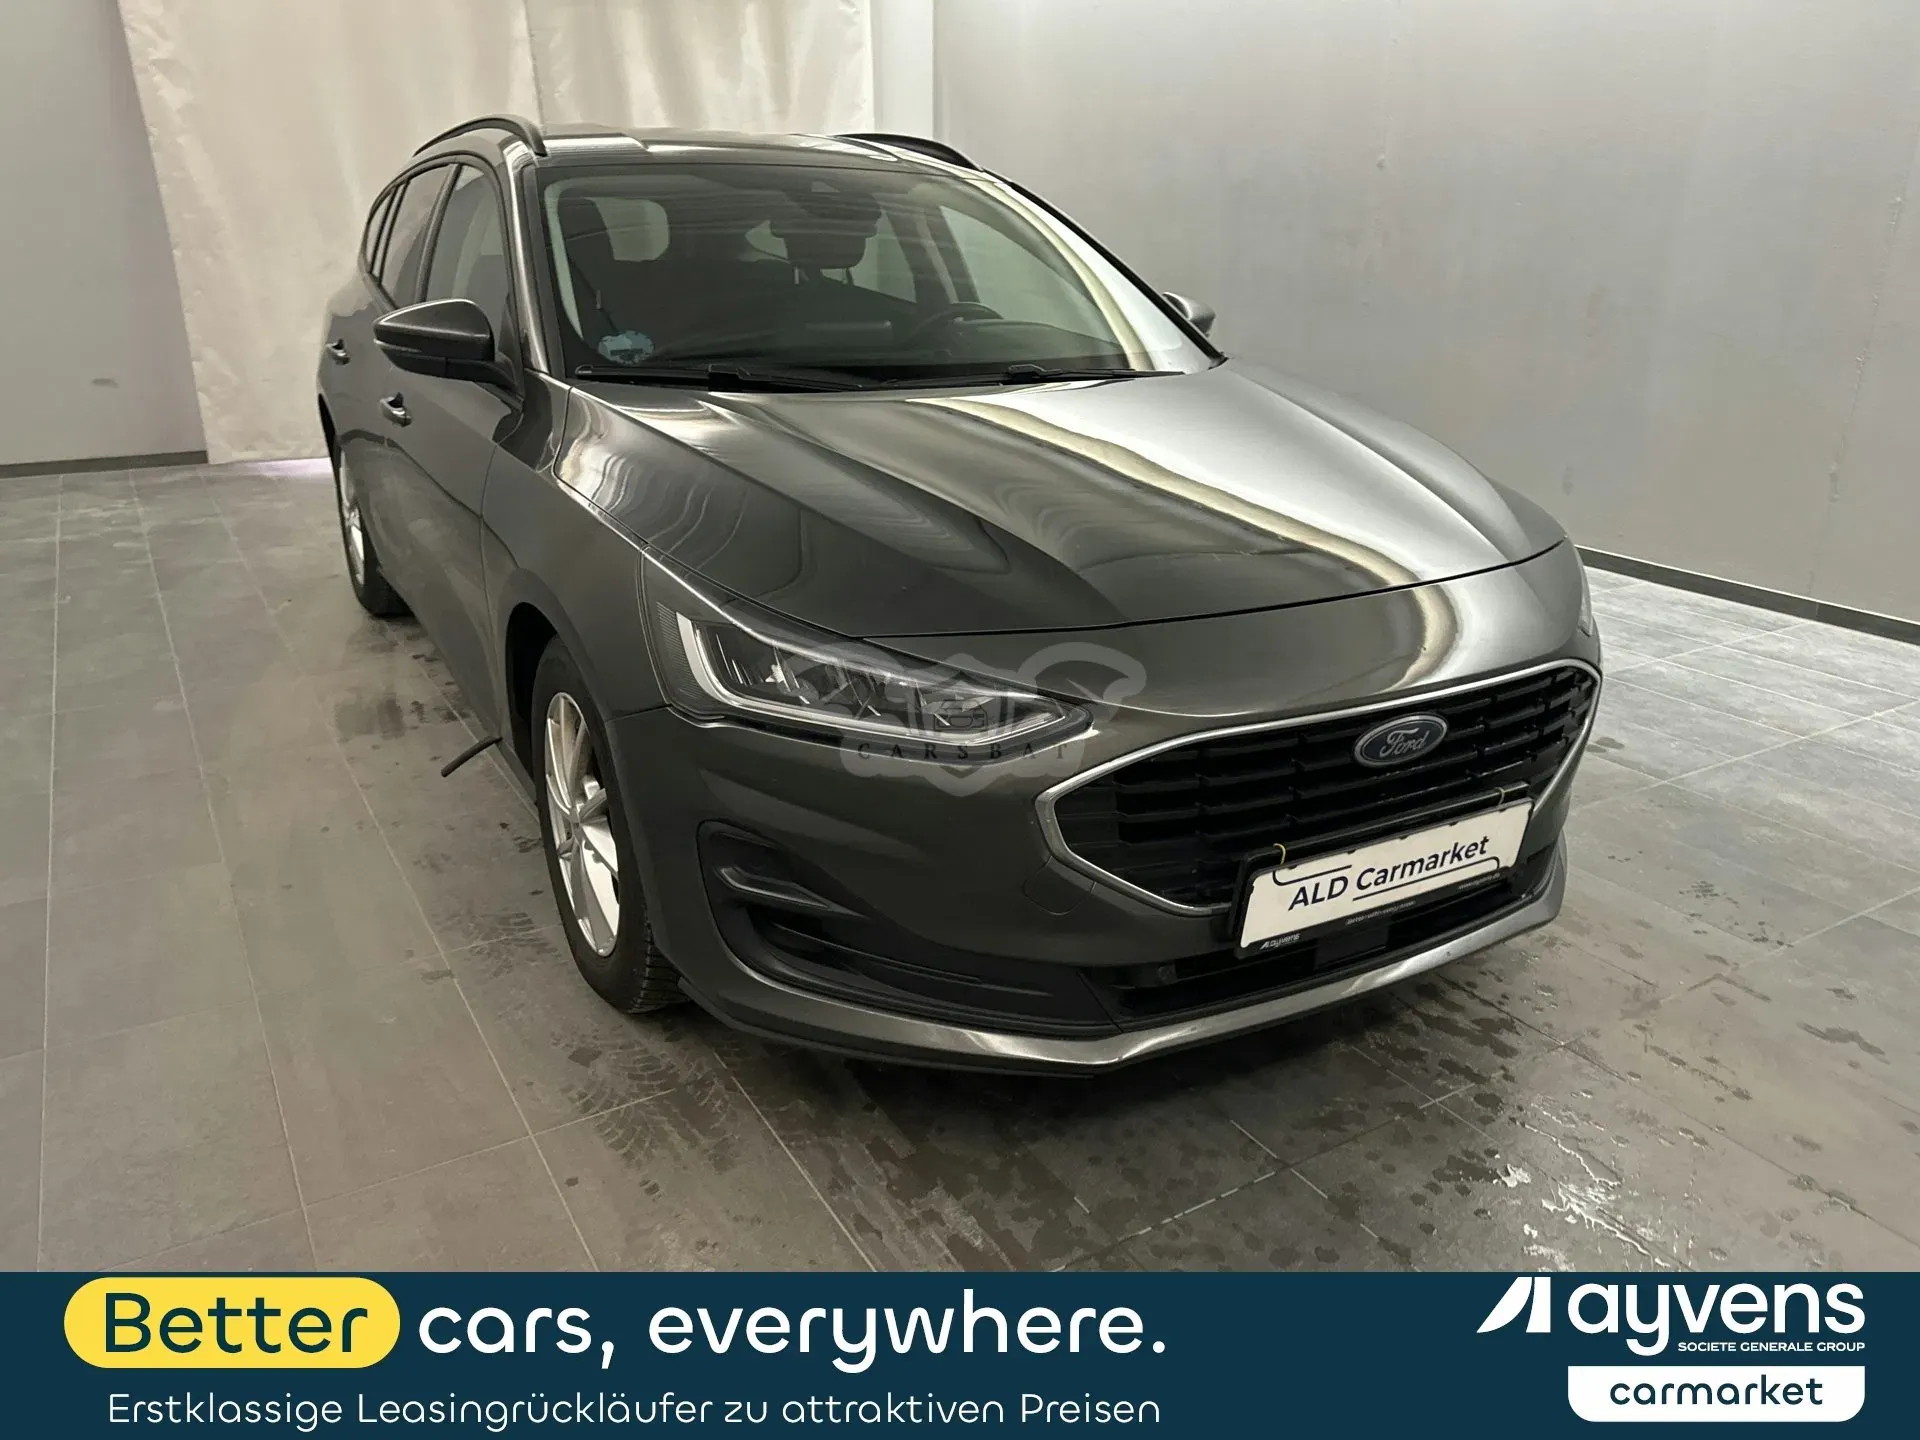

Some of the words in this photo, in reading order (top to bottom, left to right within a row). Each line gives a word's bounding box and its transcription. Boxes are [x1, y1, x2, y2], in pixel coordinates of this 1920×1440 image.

[1379, 727, 1430, 757] Ford
[1287, 875, 1348, 911] ALD
[1356, 836, 1489, 891] Carmarket
